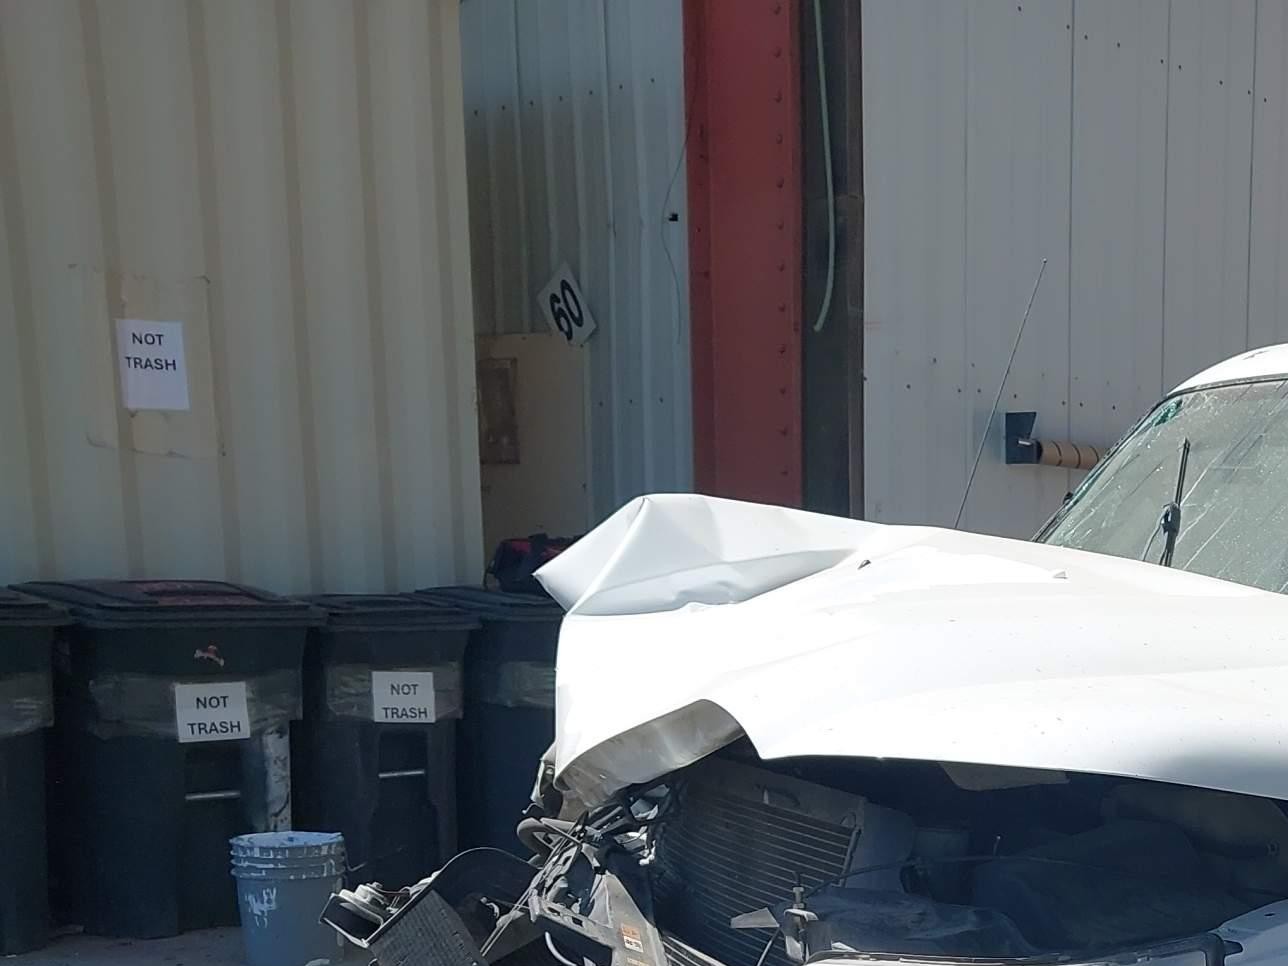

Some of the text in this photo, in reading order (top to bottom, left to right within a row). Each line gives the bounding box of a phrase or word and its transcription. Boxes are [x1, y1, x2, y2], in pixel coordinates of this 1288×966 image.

[550, 280, 584, 341] 60
[131, 332, 164, 346] NOT
[125, 356, 177, 371] TRASH
[390, 683, 419, 695] NOT
[195, 695, 230, 709] NOT
[381, 707, 428, 719] TRASH
[187, 721, 241, 735] TRASH
